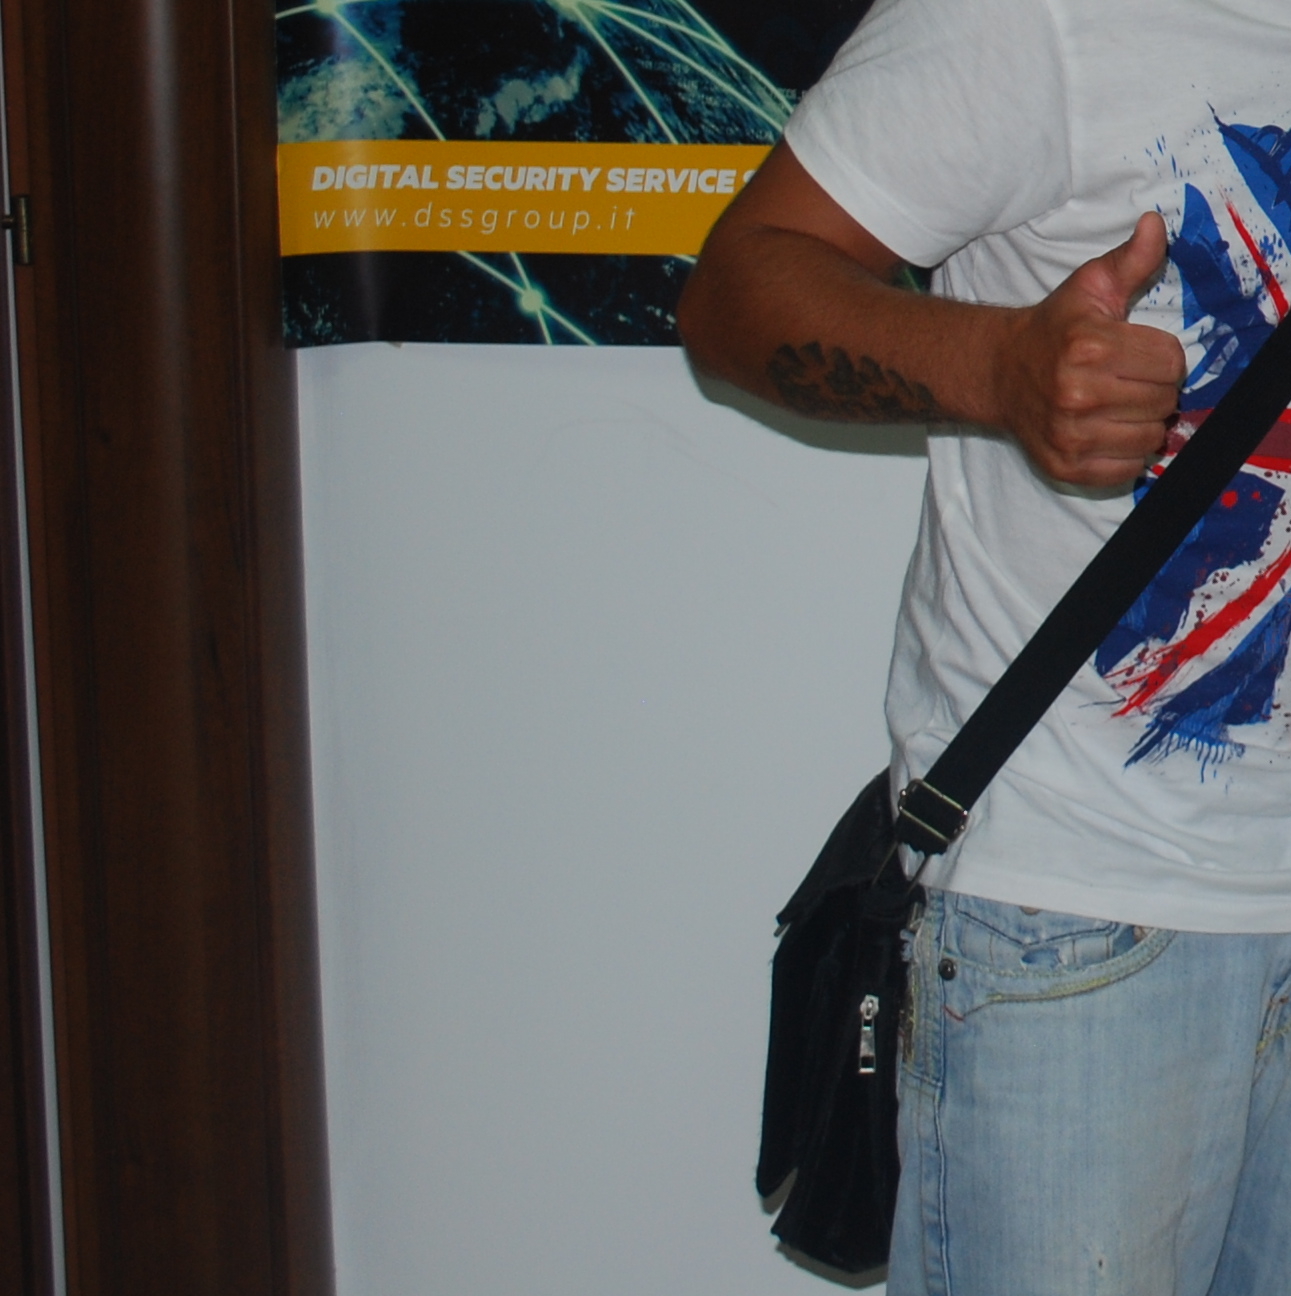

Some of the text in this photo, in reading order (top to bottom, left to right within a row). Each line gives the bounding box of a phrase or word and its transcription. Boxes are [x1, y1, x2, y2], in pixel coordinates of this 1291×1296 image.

[311, 163, 440, 192] DIGITAL
[446, 166, 601, 192] SECURITY
[605, 167, 738, 194] SERVICE
[313, 202, 638, 235] www.dssgroup.it
